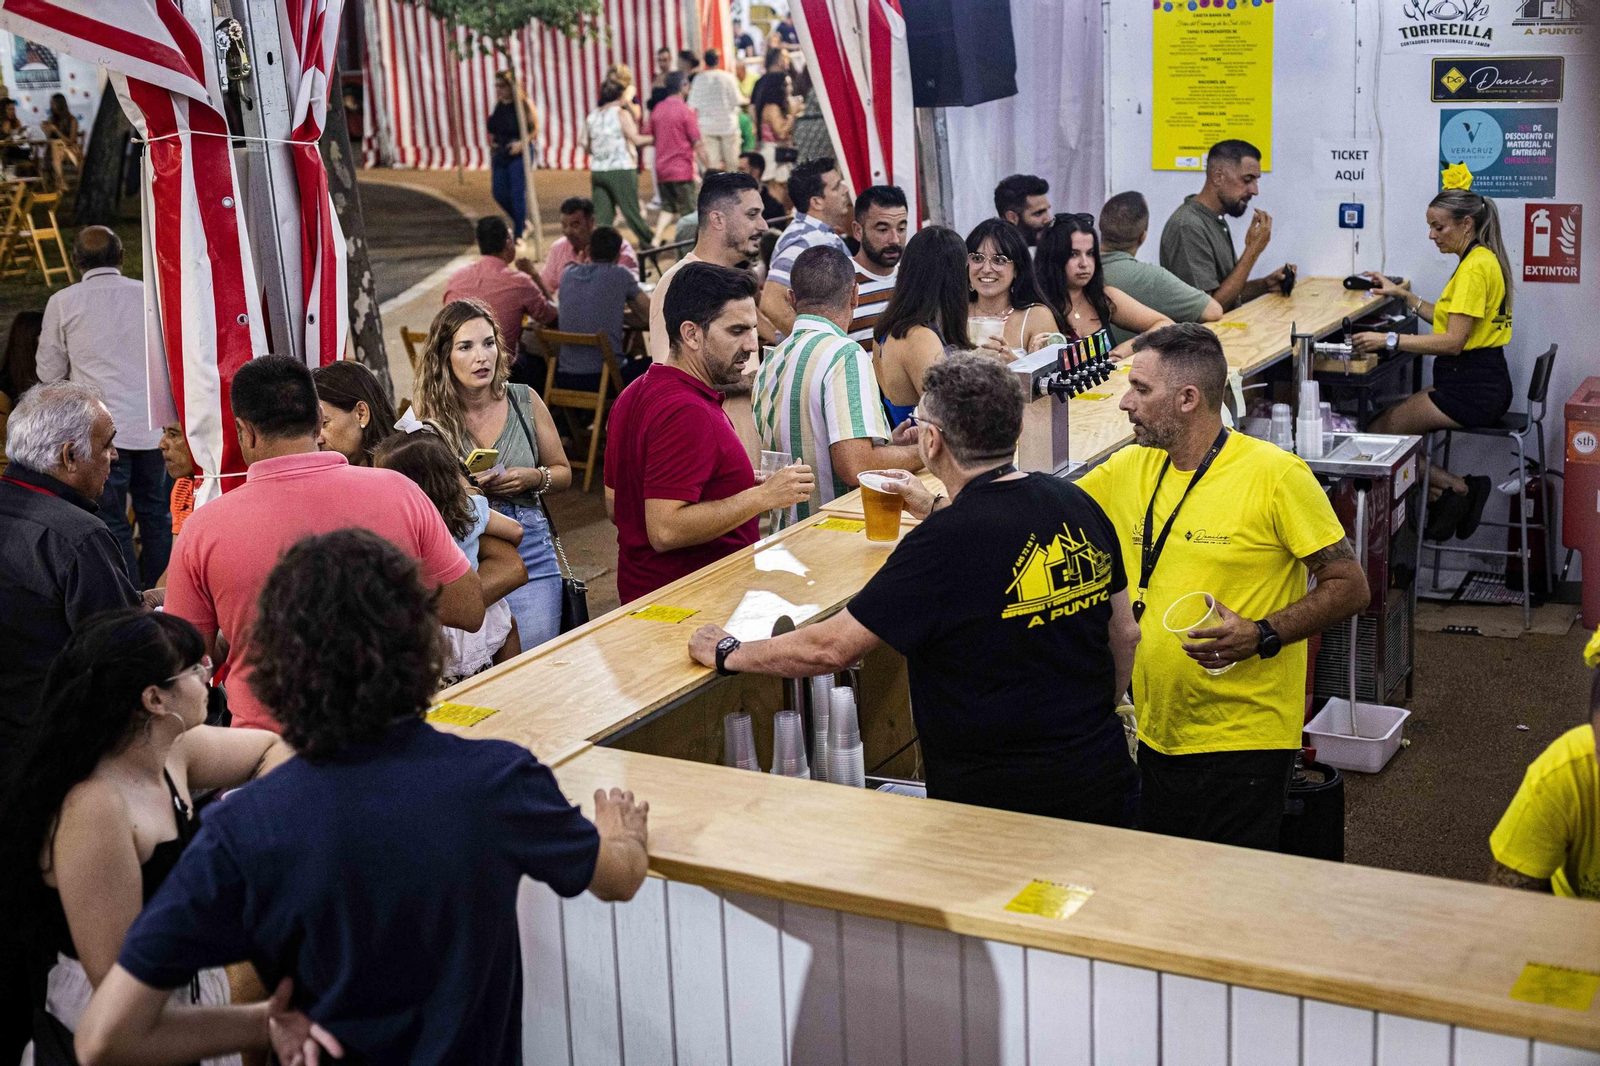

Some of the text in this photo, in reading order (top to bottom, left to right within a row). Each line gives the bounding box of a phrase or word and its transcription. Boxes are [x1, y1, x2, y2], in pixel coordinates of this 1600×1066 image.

[1398, 23, 1493, 41] TORRECILLA
[1538, 27, 1583, 35] PUNTO
[1400, 38, 1430, 47] CORTADORES
[1469, 66, 1554, 91] Danilos
[1532, 124, 1543, 132] DE
[1504, 132, 1554, 140] DESCUENTO EN
[1506, 140, 1552, 148] MATERIAL AL
[1331, 150, 1369, 160] TICKET
[1511, 148, 1547, 156] ENTREGAR
[1335, 168, 1365, 181] AQUÍ
[1525, 265, 1578, 276] EXTINTOR
[1576, 435, 1594, 447] sth
[1027, 590, 1110, 629] A PUNTO
